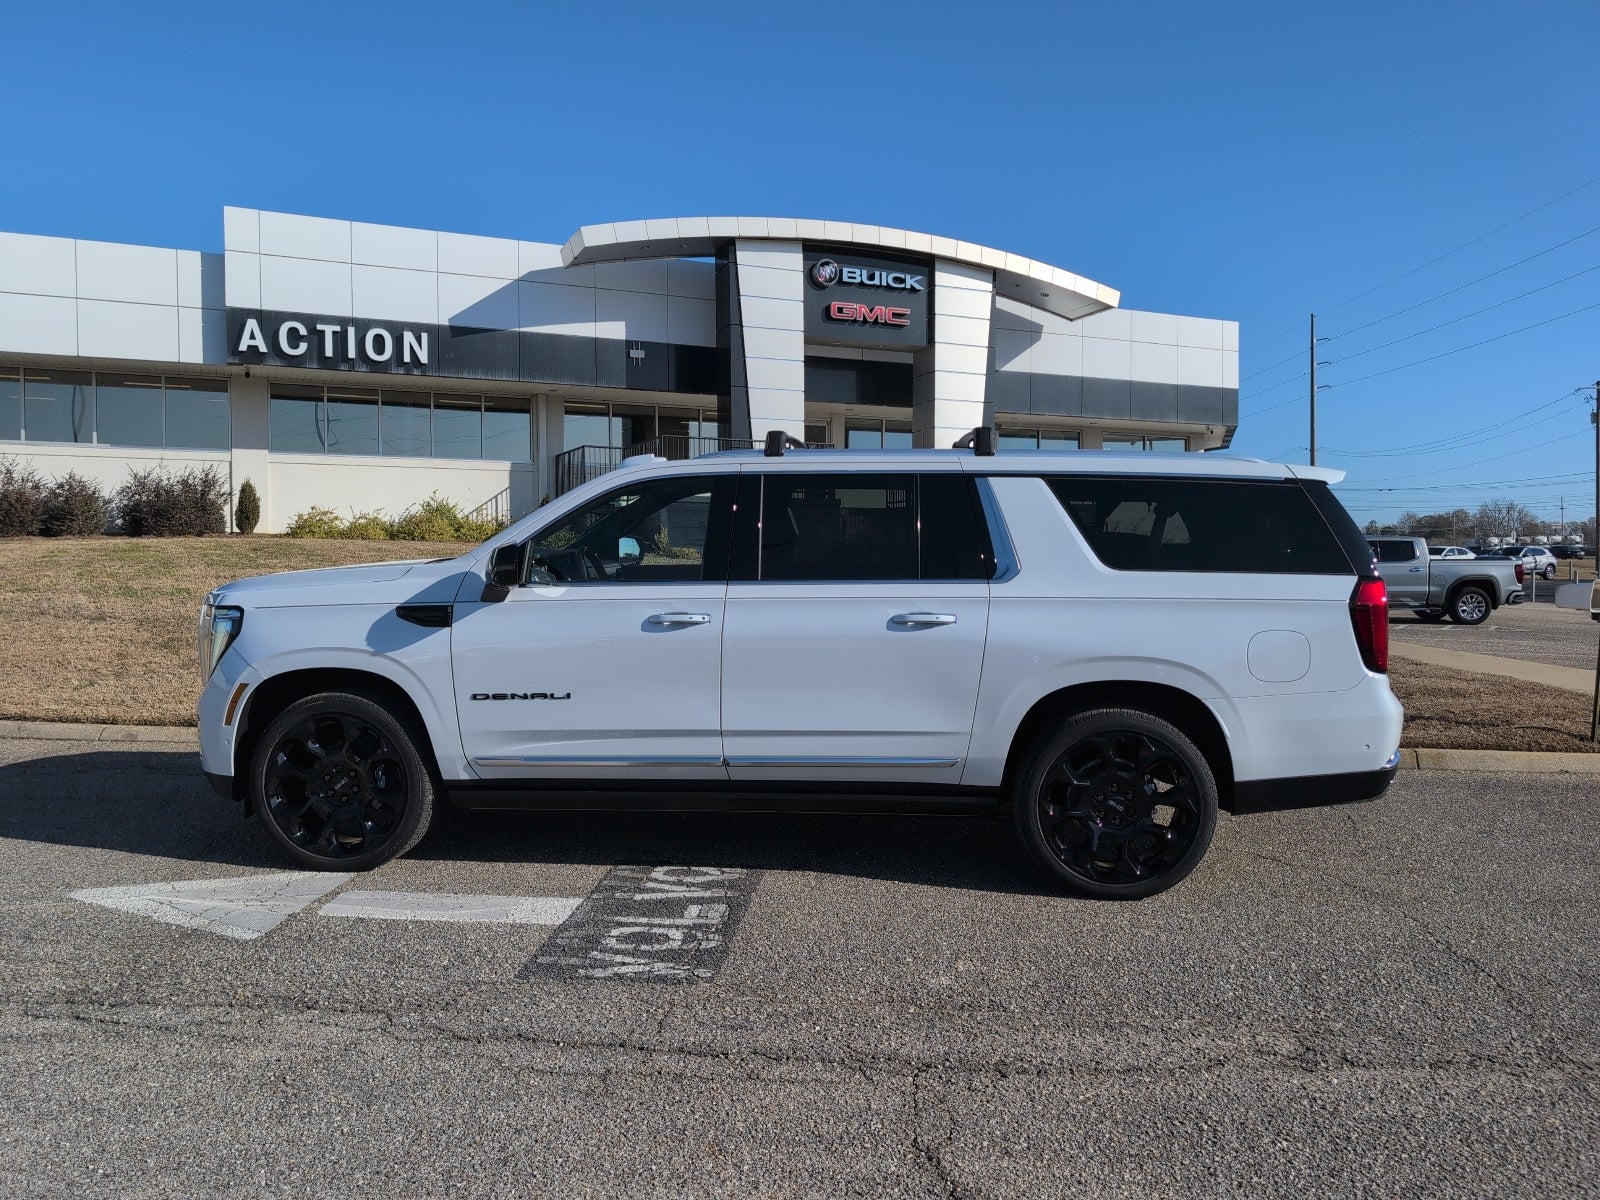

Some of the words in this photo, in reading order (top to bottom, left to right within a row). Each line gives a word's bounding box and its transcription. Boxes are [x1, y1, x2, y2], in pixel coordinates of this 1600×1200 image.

[842, 267, 925, 291] BUICK
[830, 301, 911, 326] GMC
[238, 318, 429, 364] ACTION
[470, 692, 571, 701] DENALI
